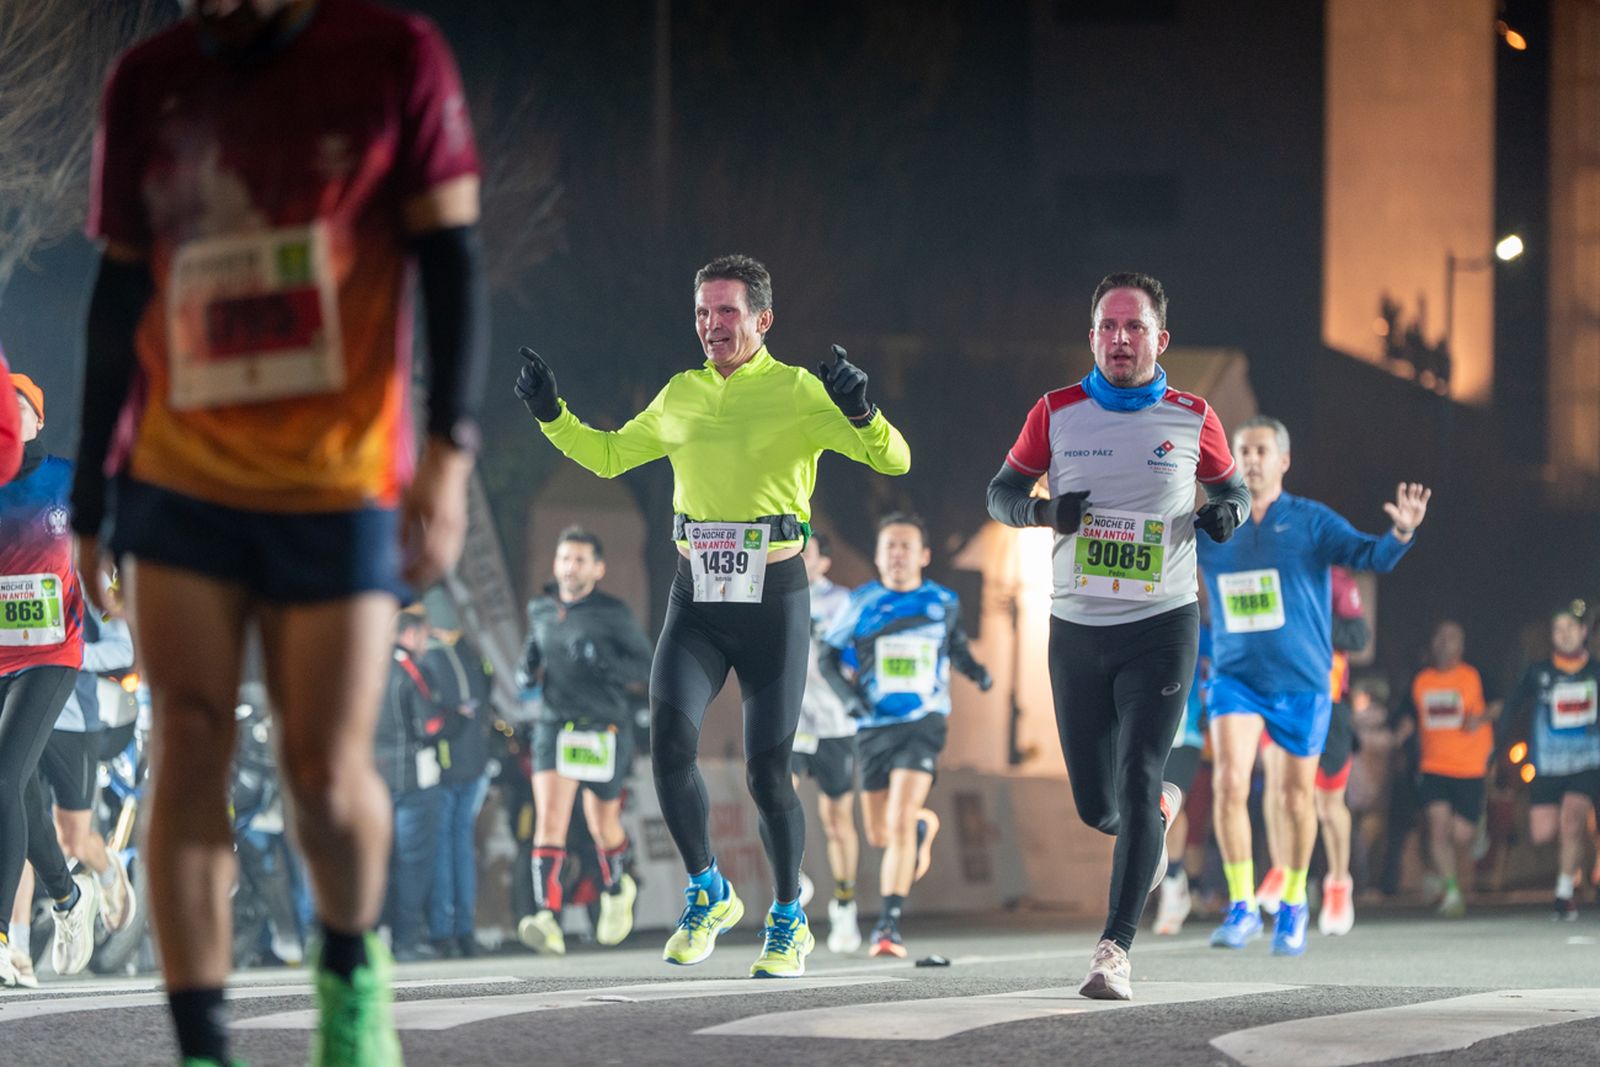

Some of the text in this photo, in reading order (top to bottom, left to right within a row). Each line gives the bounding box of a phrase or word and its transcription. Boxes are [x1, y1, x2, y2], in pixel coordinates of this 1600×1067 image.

[1064, 448, 1113, 457] PEDRO PÁEZ
[1147, 459, 1178, 468] Domino's
[1094, 518, 1123, 529] NOCHE
[1124, 520, 1136, 531] DE
[702, 531, 736, 539] NOCHE DE
[1083, 527, 1101, 538] SAN
[1102, 529, 1135, 542] ANTÓN
[694, 541, 710, 549] SAN
[710, 540, 736, 549] ANTÓN
[1087, 539, 1152, 571] 9085
[700, 551, 749, 574] 1439
[1108, 569, 1126, 577] Pedro
[1, 583, 23, 591] NOCHE
[5, 600, 44, 622] 863
